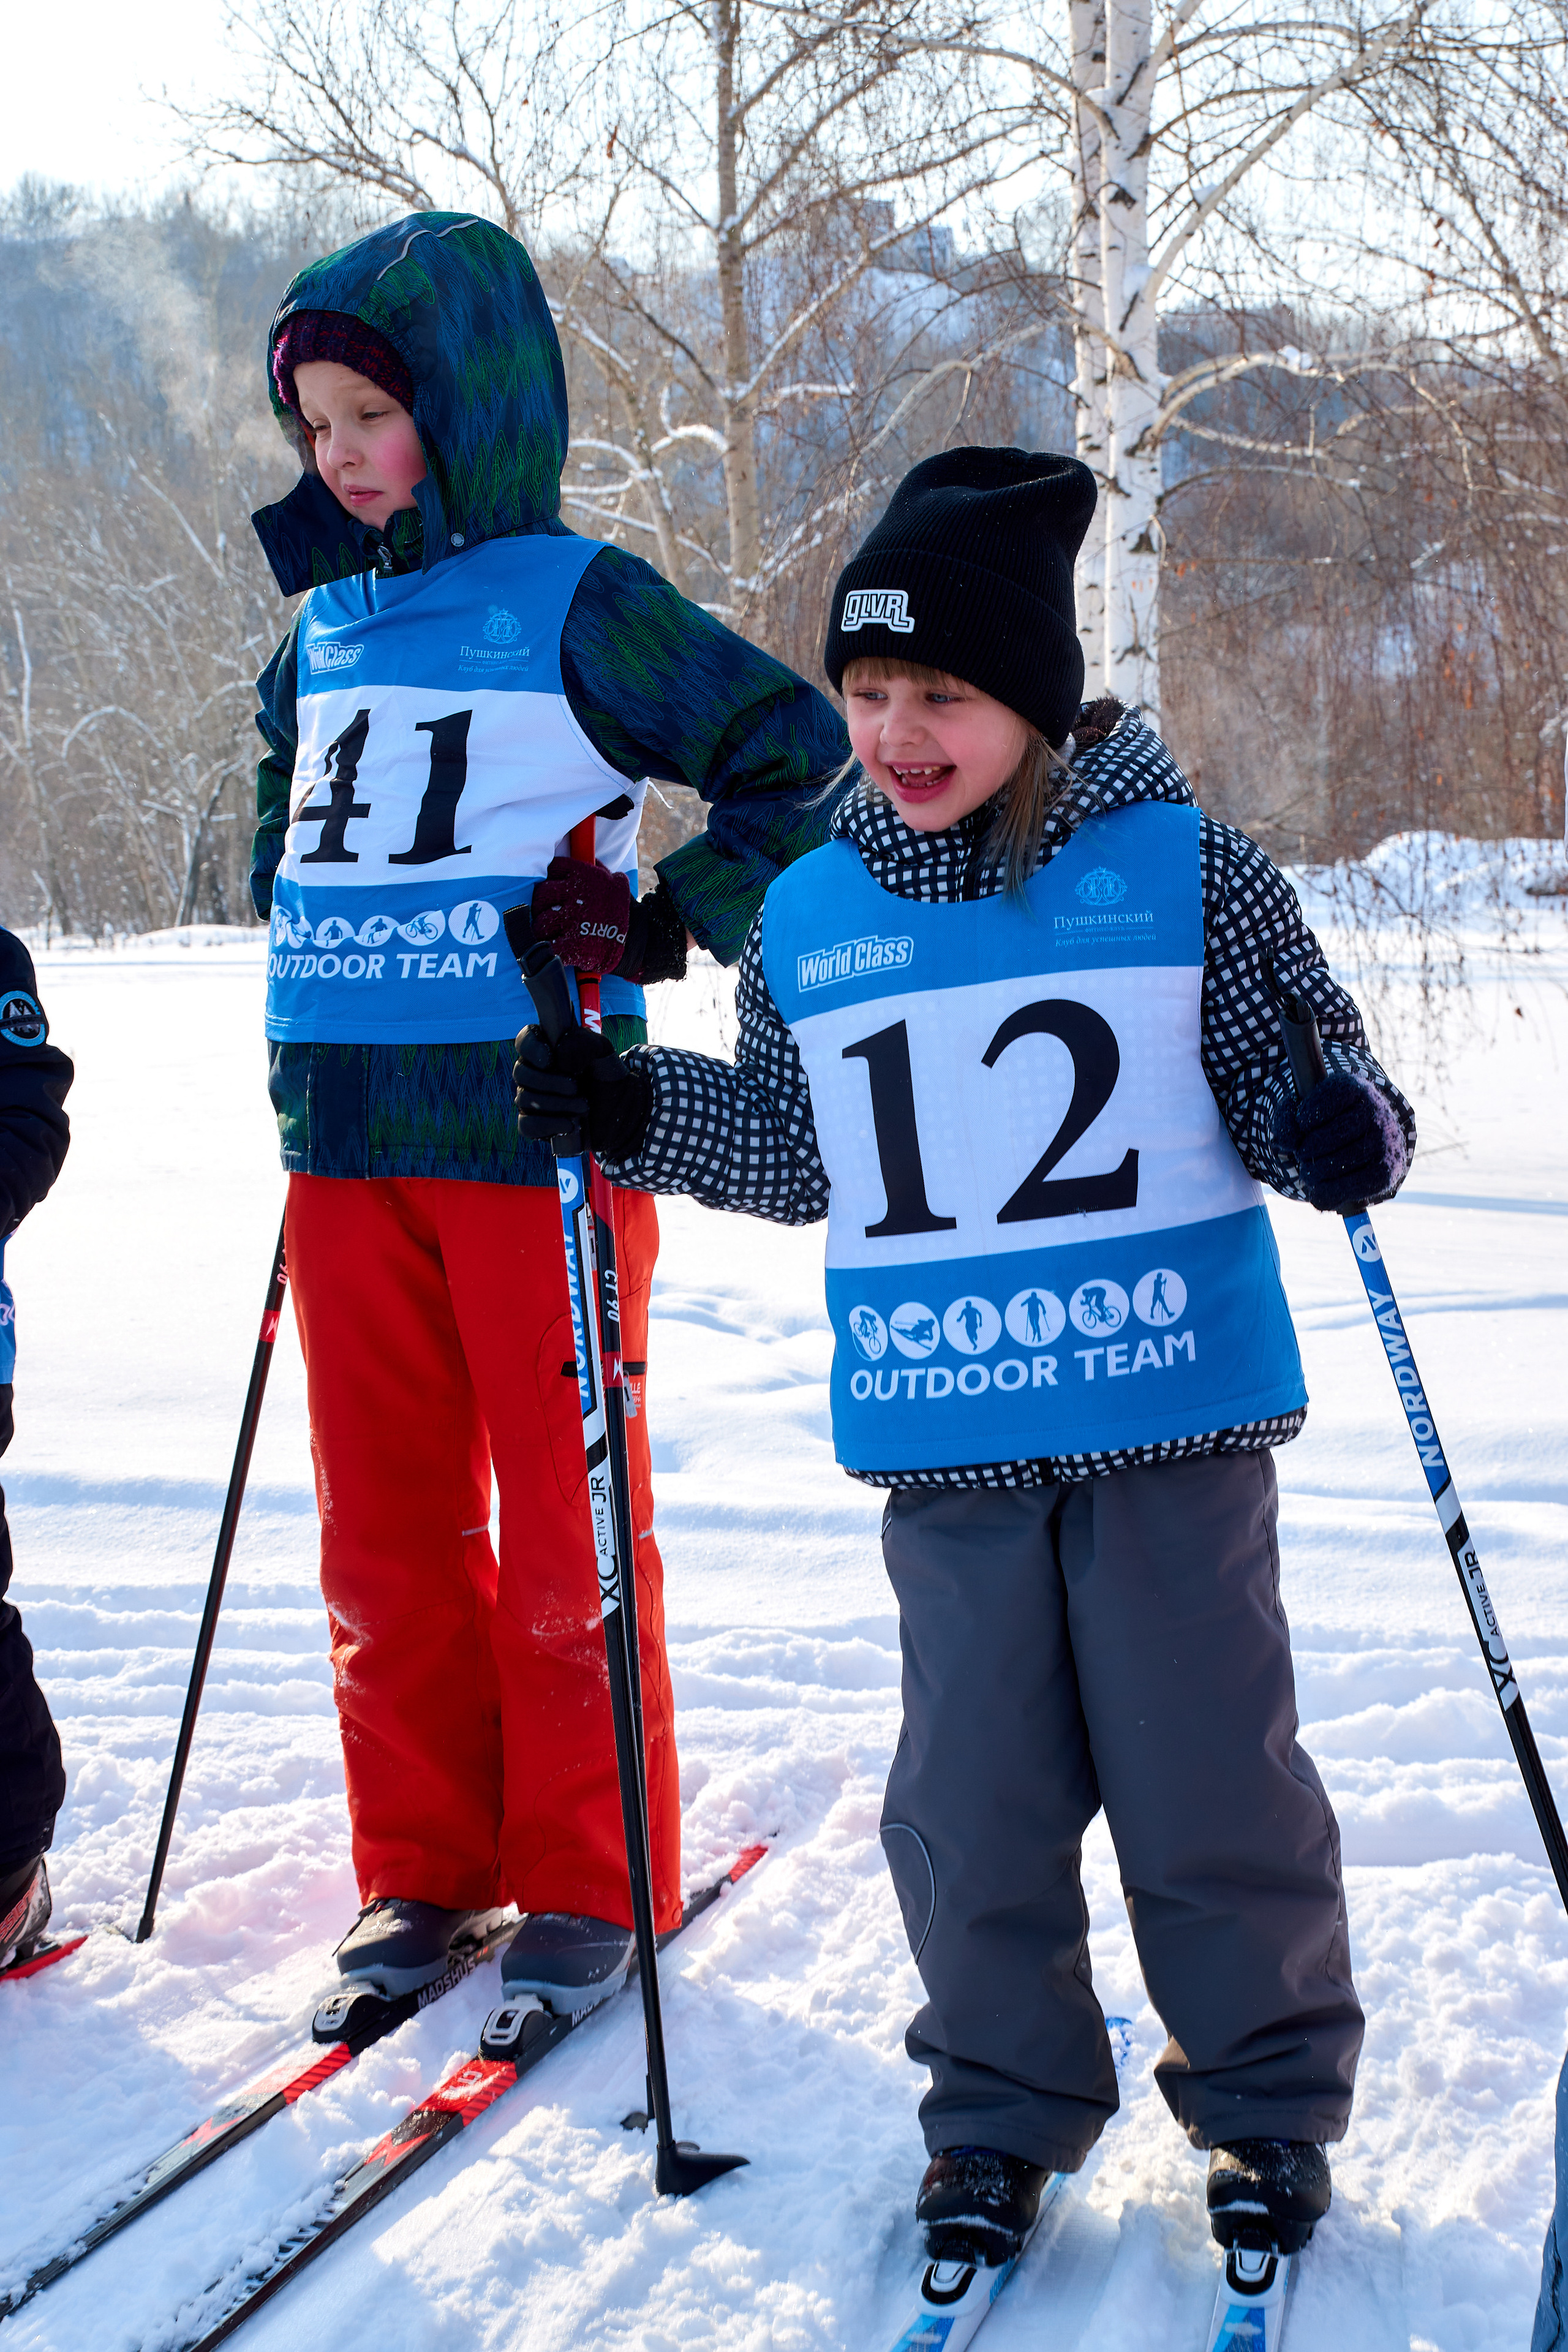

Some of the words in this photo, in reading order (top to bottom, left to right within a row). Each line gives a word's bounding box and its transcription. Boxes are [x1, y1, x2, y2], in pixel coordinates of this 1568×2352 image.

[325, 646, 361, 668] Class
[460, 646, 530, 660] Пушкинский
[293, 708, 473, 864] 41
[1054, 910, 1153, 930] Пушкинский
[268, 953, 386, 979] OUTDOOR
[396, 952, 498, 979] TEAM
[801, 946, 852, 987] World
[854, 940, 909, 971] Class
[842, 998, 1140, 1238] 12
[850, 1355, 1058, 1401] OUTDOOR
[1074, 1330, 1196, 1382] TEAM
[1368, 1288, 1444, 1468] NORDWAY
[590, 1475, 607, 1503] JR
[595, 1507, 609, 1557] ACTIVE
[1464, 1549, 1483, 1580] JR
[1476, 1583, 1500, 1637] ACTIVE
[417, 1956, 476, 2010] MADSHUS
